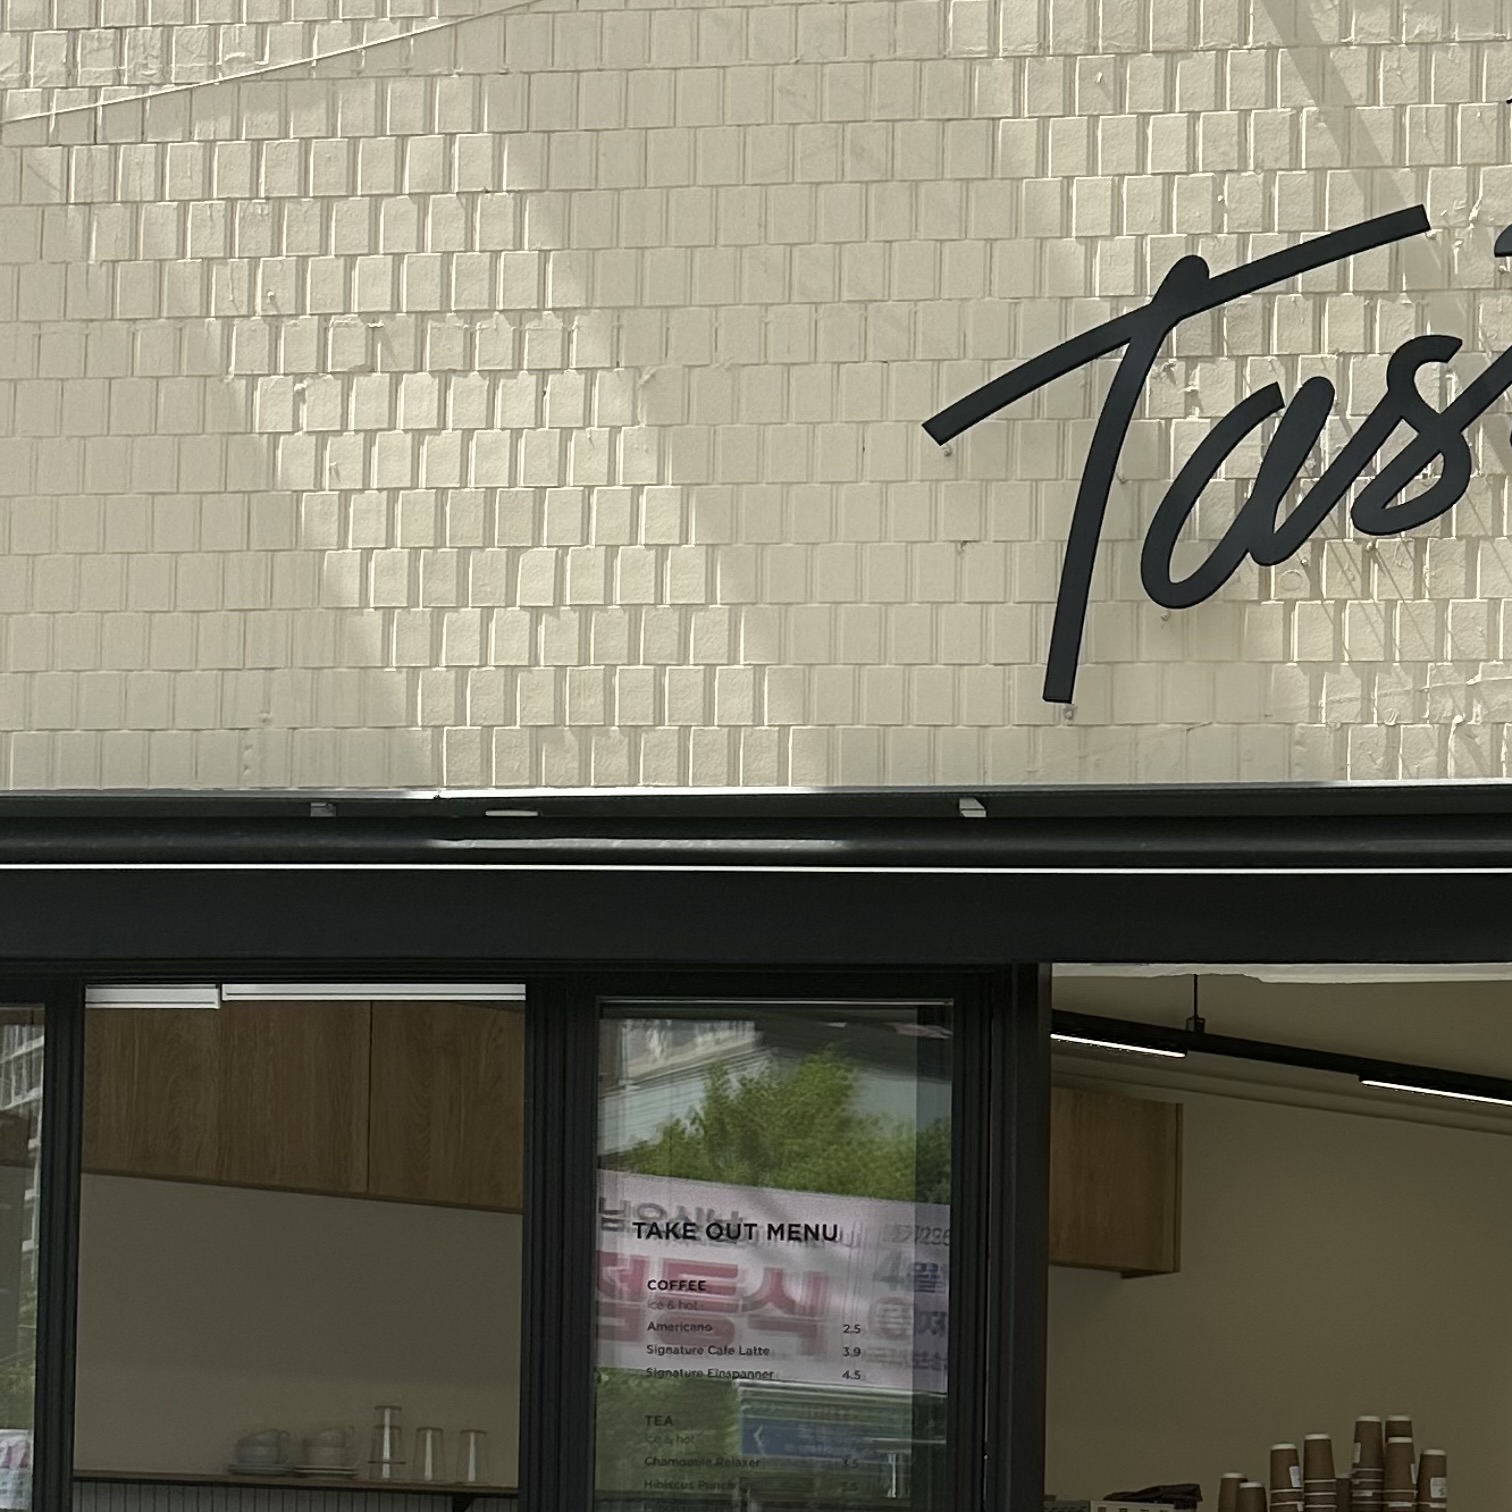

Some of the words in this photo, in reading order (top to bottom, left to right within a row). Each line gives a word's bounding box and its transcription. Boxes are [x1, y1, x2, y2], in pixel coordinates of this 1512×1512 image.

[633, 1222, 697, 1240] TAKE
[705, 1223, 758, 1241] OUT
[766, 1224, 839, 1242] MENU
[647, 1280, 707, 1292] COFFEE
[646, 1321, 713, 1333] Americano
[842, 1324, 862, 1335] 2.5
[646, 1344, 704, 1358] Signature
[707, 1345, 736, 1357] Cafe
[738, 1345, 771, 1357] Latte
[842, 1346, 862, 1357] 3.9
[645, 1367, 704, 1381] Signature
[707, 1369, 775, 1382] Einspanner
[842, 1369, 862, 1380] 4.5
[645, 1415, 674, 1427] TEA
[716, 1457, 761, 1468] Relaxer
[644, 1479, 695, 1490] Hibiscus
